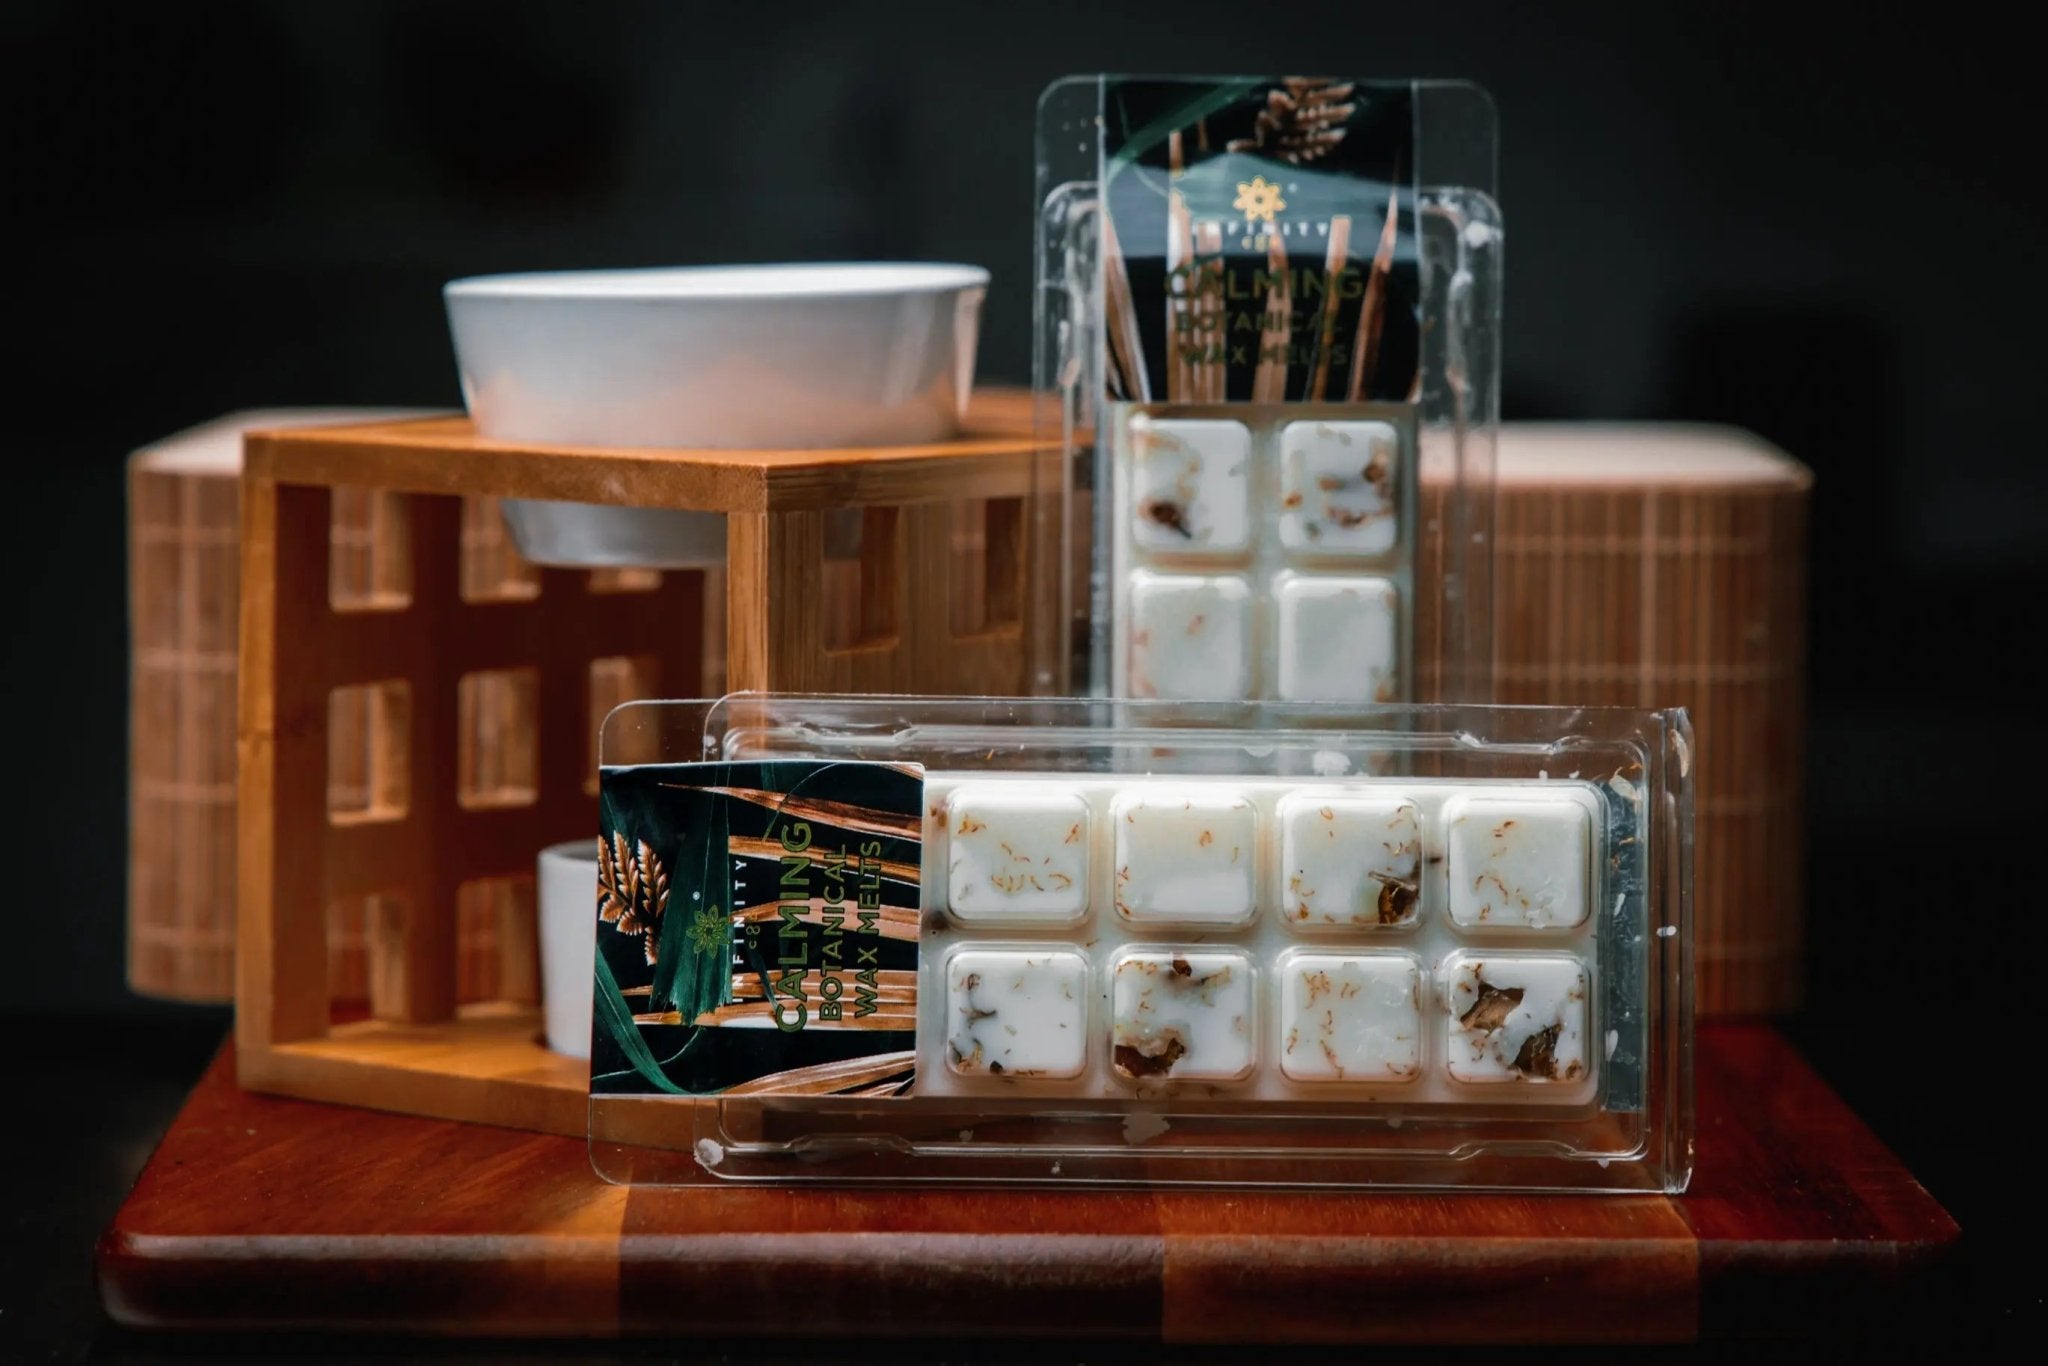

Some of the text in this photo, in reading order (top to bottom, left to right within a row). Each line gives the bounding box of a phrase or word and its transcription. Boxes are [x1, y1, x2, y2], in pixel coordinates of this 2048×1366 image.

[1165, 267, 1364, 299] CALMING
[1175, 311, 1343, 331] BOTANICAL
[732, 859, 748, 1004] INFINITY
[776, 822, 813, 1033] CALMING
[819, 844, 848, 1022] BOTANICAL
[854, 840, 882, 1019] WAX MELTS
